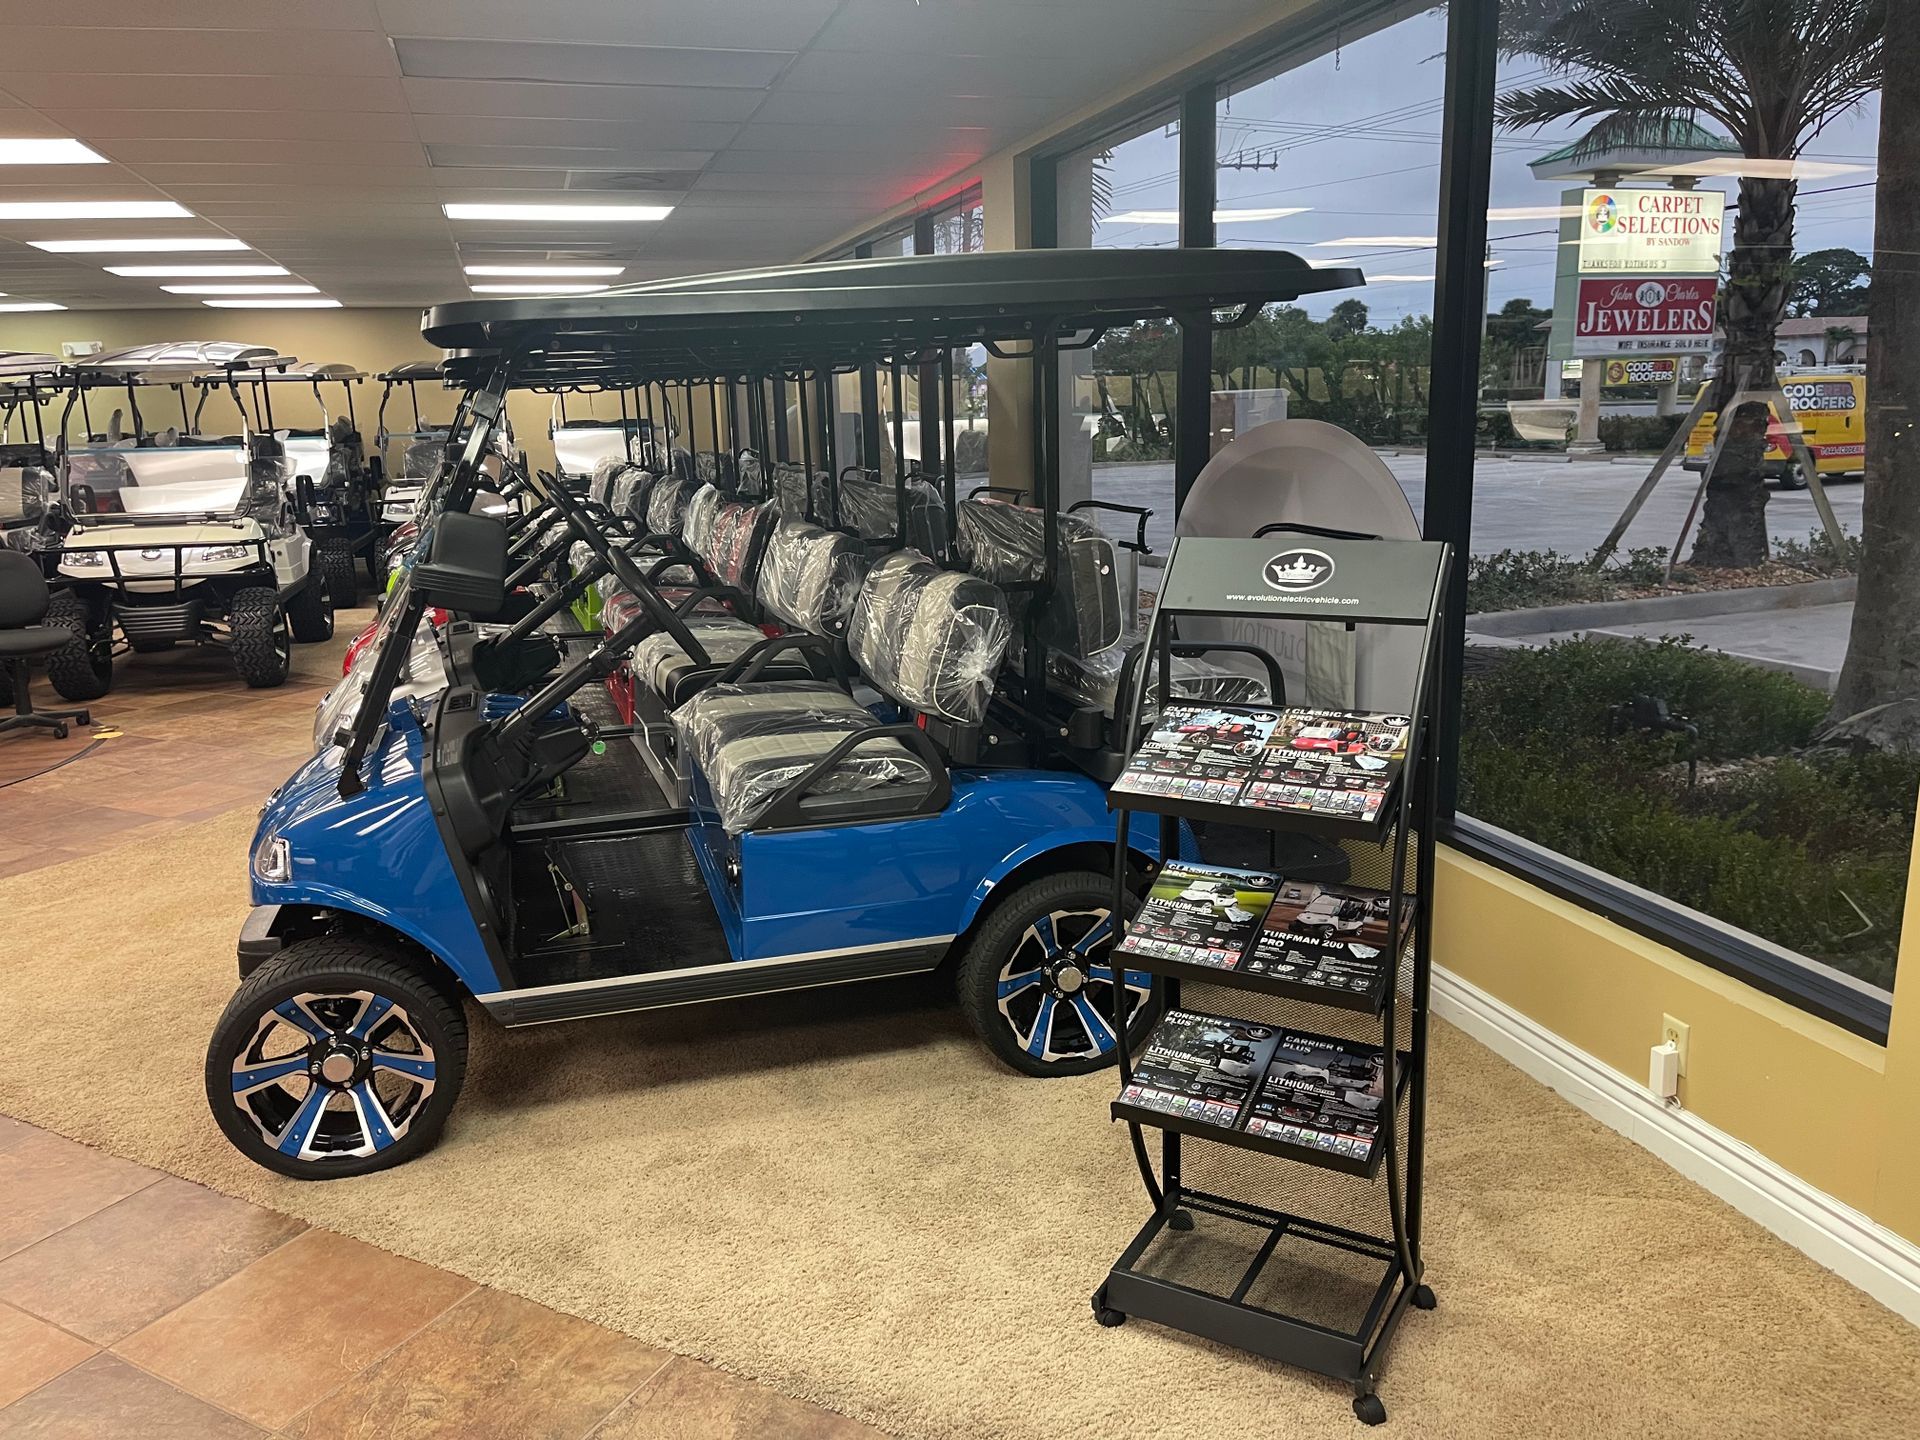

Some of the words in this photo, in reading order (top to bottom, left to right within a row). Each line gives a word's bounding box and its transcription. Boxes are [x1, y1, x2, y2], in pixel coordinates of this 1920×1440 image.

[1639, 196, 1703, 214] CARPET
[1617, 217, 1719, 235] SELECTIONS
[1646, 238, 1656, 246] BY
[1658, 238, 1690, 246] SANDOW
[1600, 283, 1632, 308] John
[1665, 283, 1699, 302] Charles
[1580, 301, 1713, 333] JEWELERS
[1629, 371, 1673, 382] ROOFERS
[1789, 396, 1855, 410] ROOFERS
[1226, 594, 1359, 606] www.evolutionelectricvehicle.com
[1166, 706, 1213, 714] CLASSIC
[1292, 708, 1342, 718] CLASSIC
[1289, 714, 1314, 722] PRO
[1271, 749, 1320, 760] LITHIUM
[1168, 863, 1213, 875] CLASSIC
[1148, 897, 1192, 910] LITHIUM
[1260, 937, 1285, 948] PRO
[1263, 929, 1320, 946] TURFMAN
[1321, 939, 1344, 949] 200
[1165, 1017, 1192, 1027] PLUS
[1168, 1010, 1223, 1027] FORESTER
[1282, 1042, 1312, 1053] PLUS
[1285, 1036, 1334, 1050] CARRIER
[1149, 1045, 1192, 1060] LITHIUM
[1267, 1076, 1314, 1092] LITHIUM
